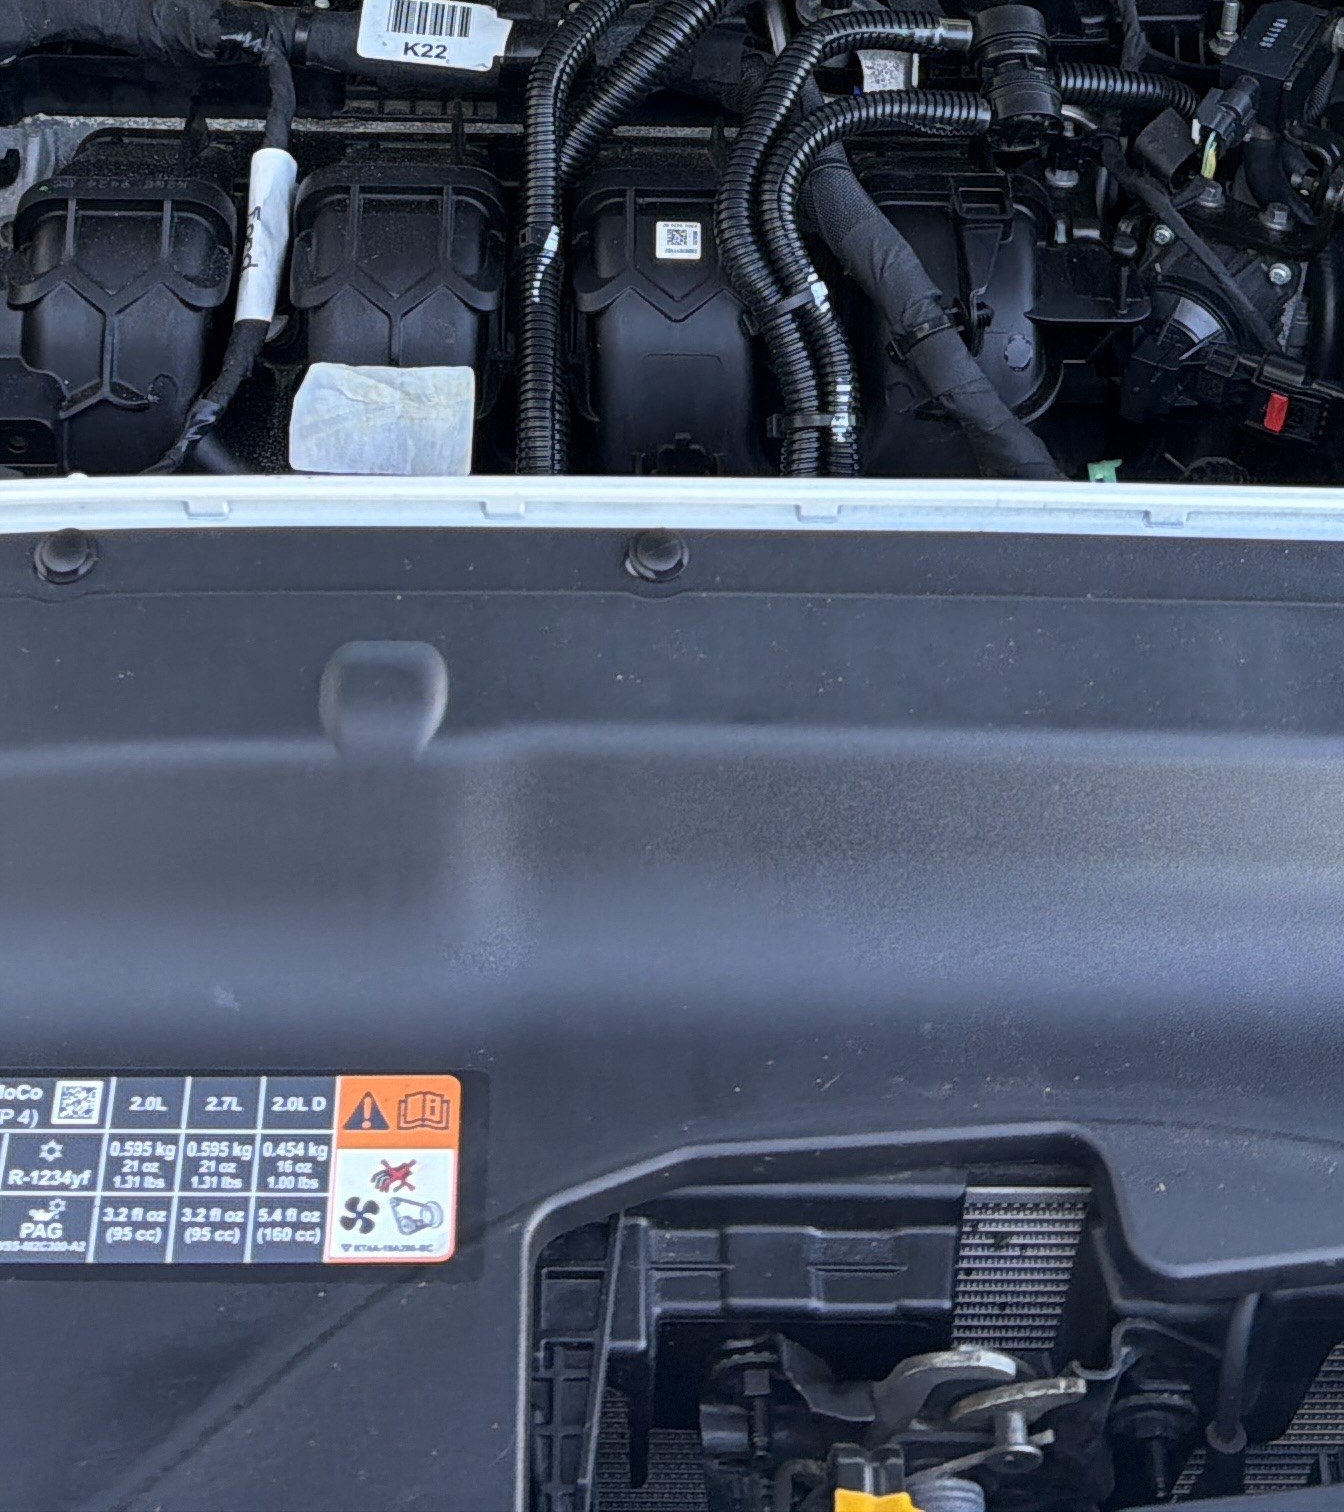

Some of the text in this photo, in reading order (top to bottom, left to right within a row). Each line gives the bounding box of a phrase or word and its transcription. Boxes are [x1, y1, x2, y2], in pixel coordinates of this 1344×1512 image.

[404, 42, 448, 59] K22
[128, 1096, 168, 1112] 2.0L
[205, 1096, 243, 1112] 2.7L
[271, 1096, 327, 1112] 2.0L D
[17, 1109, 39, 1128] 4)
[110, 1141, 176, 1161] 0.595 kg
[187, 1141, 253, 1161] 0.595 kg
[262, 1141, 328, 1161] 0.454 kg
[121, 1160, 160, 1173] 21 oz
[199, 1160, 237, 1173] 21 oz
[277, 1160, 313, 1173] 16 oz
[7, 1169, 92, 1189] R-1234yf
[113, 1176, 165, 1189] 1.31 lbs
[190, 1176, 243, 1189] 1.31 lbs
[267, 1176, 319, 1189] 1.00 lbs
[102, 1207, 167, 1222] 3.2 fl oz
[181, 1207, 245, 1222] 3.2 fl oz
[258, 1208, 321, 1222] 5.4 fl oz
[19, 1222, 63, 1239] PAG
[106, 1227, 162, 1244] (95 cc)
[184, 1227, 241, 1244] (95 cc)
[256, 1227, 321, 1244] (160 cc)
